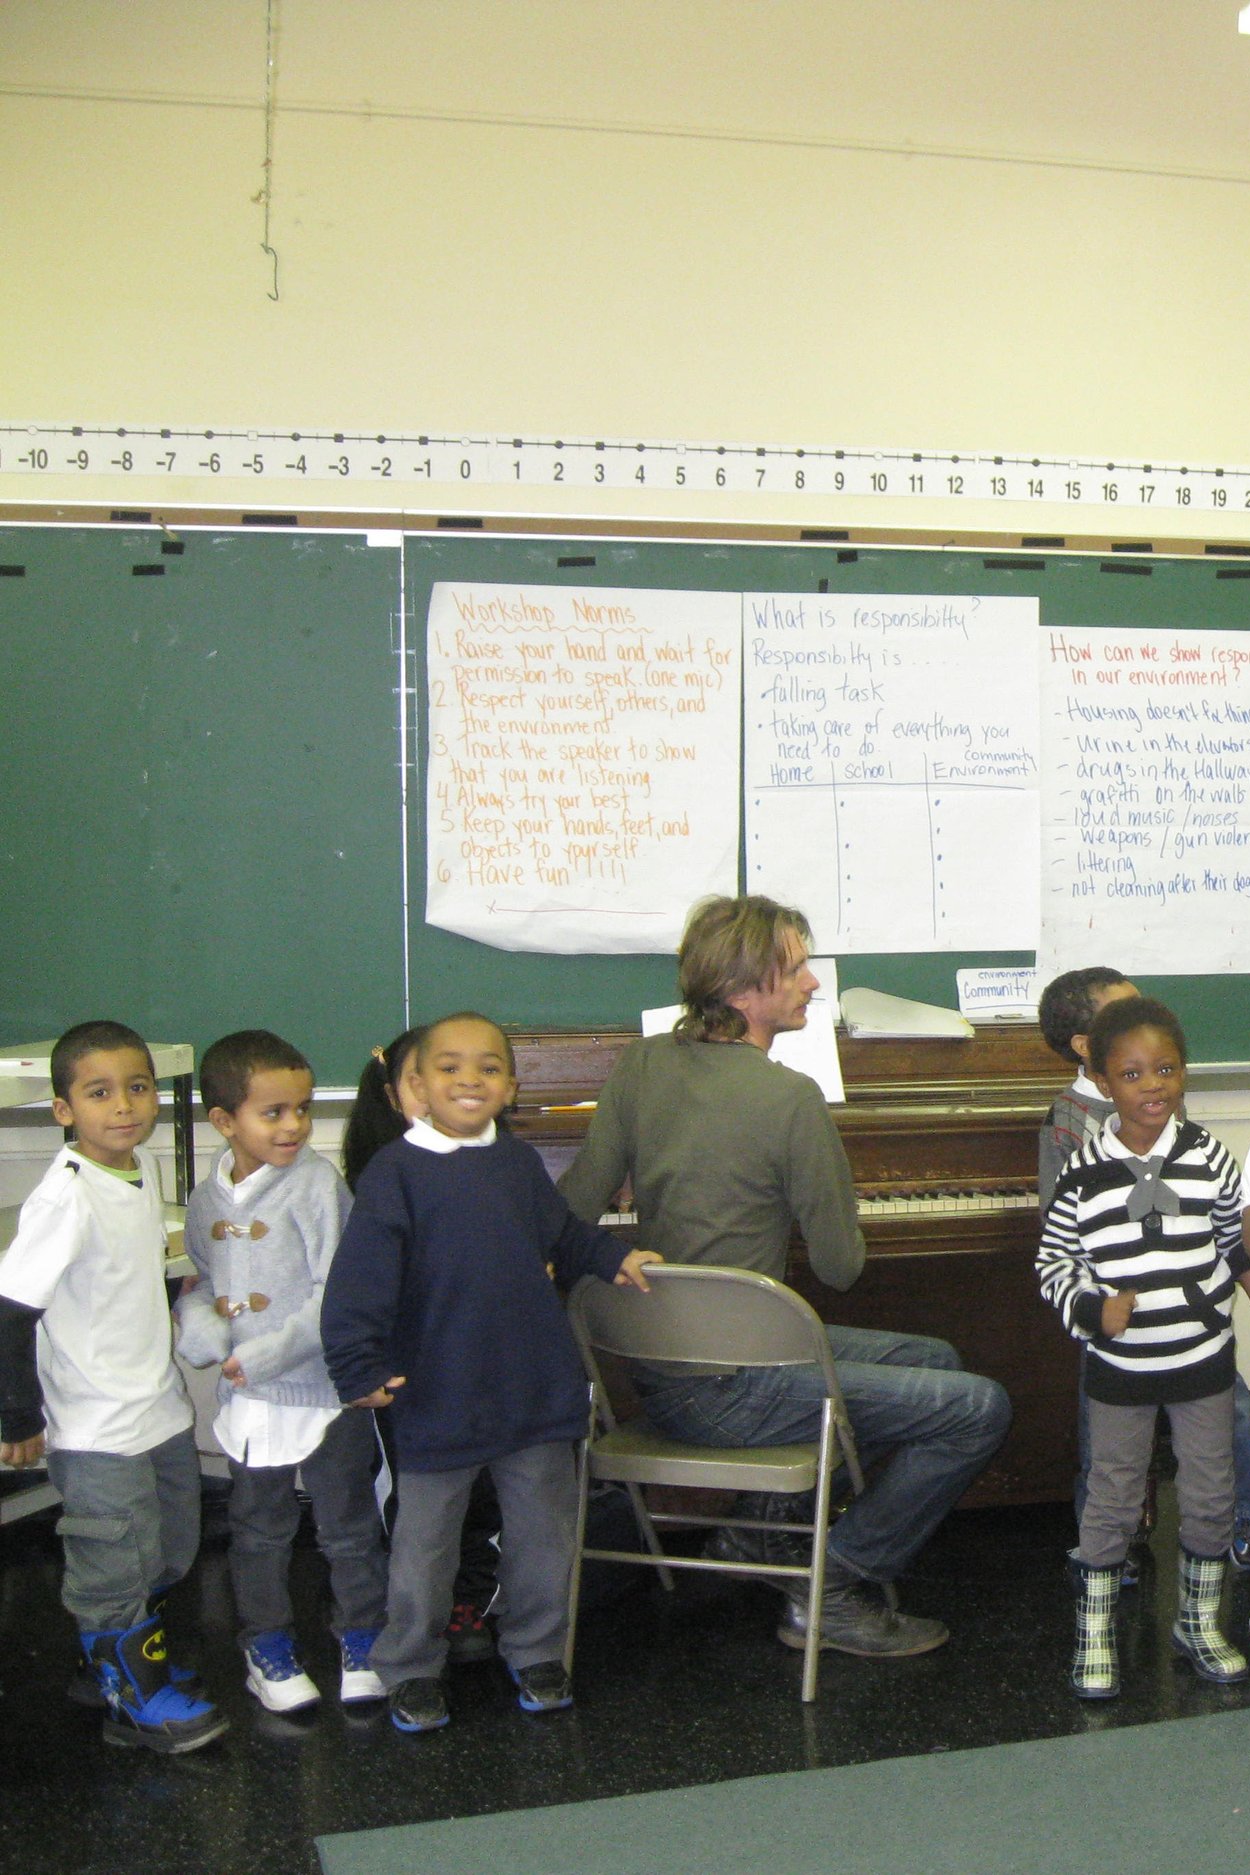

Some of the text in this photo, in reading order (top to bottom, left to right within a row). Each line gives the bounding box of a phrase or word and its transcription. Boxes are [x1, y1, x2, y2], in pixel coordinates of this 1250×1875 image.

[460, 459, 471, 480] 0
[513, 460, 520, 480] 1
[553, 461, 564, 482] 2
[594, 463, 605, 483] 3
[635, 464, 646, 484] 4
[675, 466, 686, 486] 5
[715, 467, 726, 487] 6
[755, 468, 766, 488] 7
[795, 470, 805, 490] 8
[834, 471, 845, 491] 9
[870, 472, 888, 493] 10
[909, 474, 924, 493] 11
[947, 475, 964, 495] 12
[990, 477, 1007, 496] 13
[1027, 479, 1044, 498] 14
[1065, 481, 1081, 500] 15
[1102, 483, 1118, 502] 16
[1139, 484, 1156, 503] 17
[1175, 487, 1191, 506] 18
[1211, 488, 1227, 508] 19
[452, 592, 637, 624] Workshop Norms
[752, 598, 806, 630] What
[819, 606, 836, 628] is
[455, 629, 732, 669] Raise your hand and wait for
[882, 650, 902, 667] is
[1050, 633, 1092, 663] How
[1104, 644, 1134, 663] can
[1140, 643, 1160, 662] we
[1169, 640, 1202, 663] show
[451, 665, 547, 691] permission
[553, 664, 574, 685] to
[835, 672, 885, 703] task
[1096, 669, 1121, 686] our
[459, 681, 527, 715] Respect
[676, 692, 706, 713] and
[460, 711, 491, 738] the
[770, 708, 1010, 747] taking care of everything you
[1066, 695, 1143, 733] Housing
[1146, 698, 1198, 723] doesn't
[1202, 699, 1224, 724] fix
[456, 733, 697, 768] Track the speaker to show
[778, 739, 840, 760] need to
[1143, 735, 1161, 752] in
[1163, 732, 1196, 754] the
[449, 760, 652, 797] that you are listening
[770, 762, 814, 787] Home
[1076, 757, 1137, 787] drugs
[1140, 758, 1158, 781] in
[1163, 755, 1189, 780] the
[456, 786, 631, 818] Always try your best
[1155, 785, 1174, 804] on
[1178, 780, 1205, 803] the
[1210, 783, 1246, 804] walls
[463, 807, 505, 839] Keep
[512, 817, 554, 842] your
[661, 810, 690, 838] and
[1074, 803, 1121, 828] loud
[1128, 808, 1175, 827] music
[529, 838, 551, 860] to
[1174, 832, 1208, 859] gun
[466, 859, 571, 889] Have fun
[1076, 849, 1137, 883] littering
[1072, 874, 1096, 897] not
[1106, 877, 1167, 907] cleaning
[1168, 872, 1196, 894] after
[1203, 869, 1228, 892] their
[964, 977, 1030, 1001] Community
